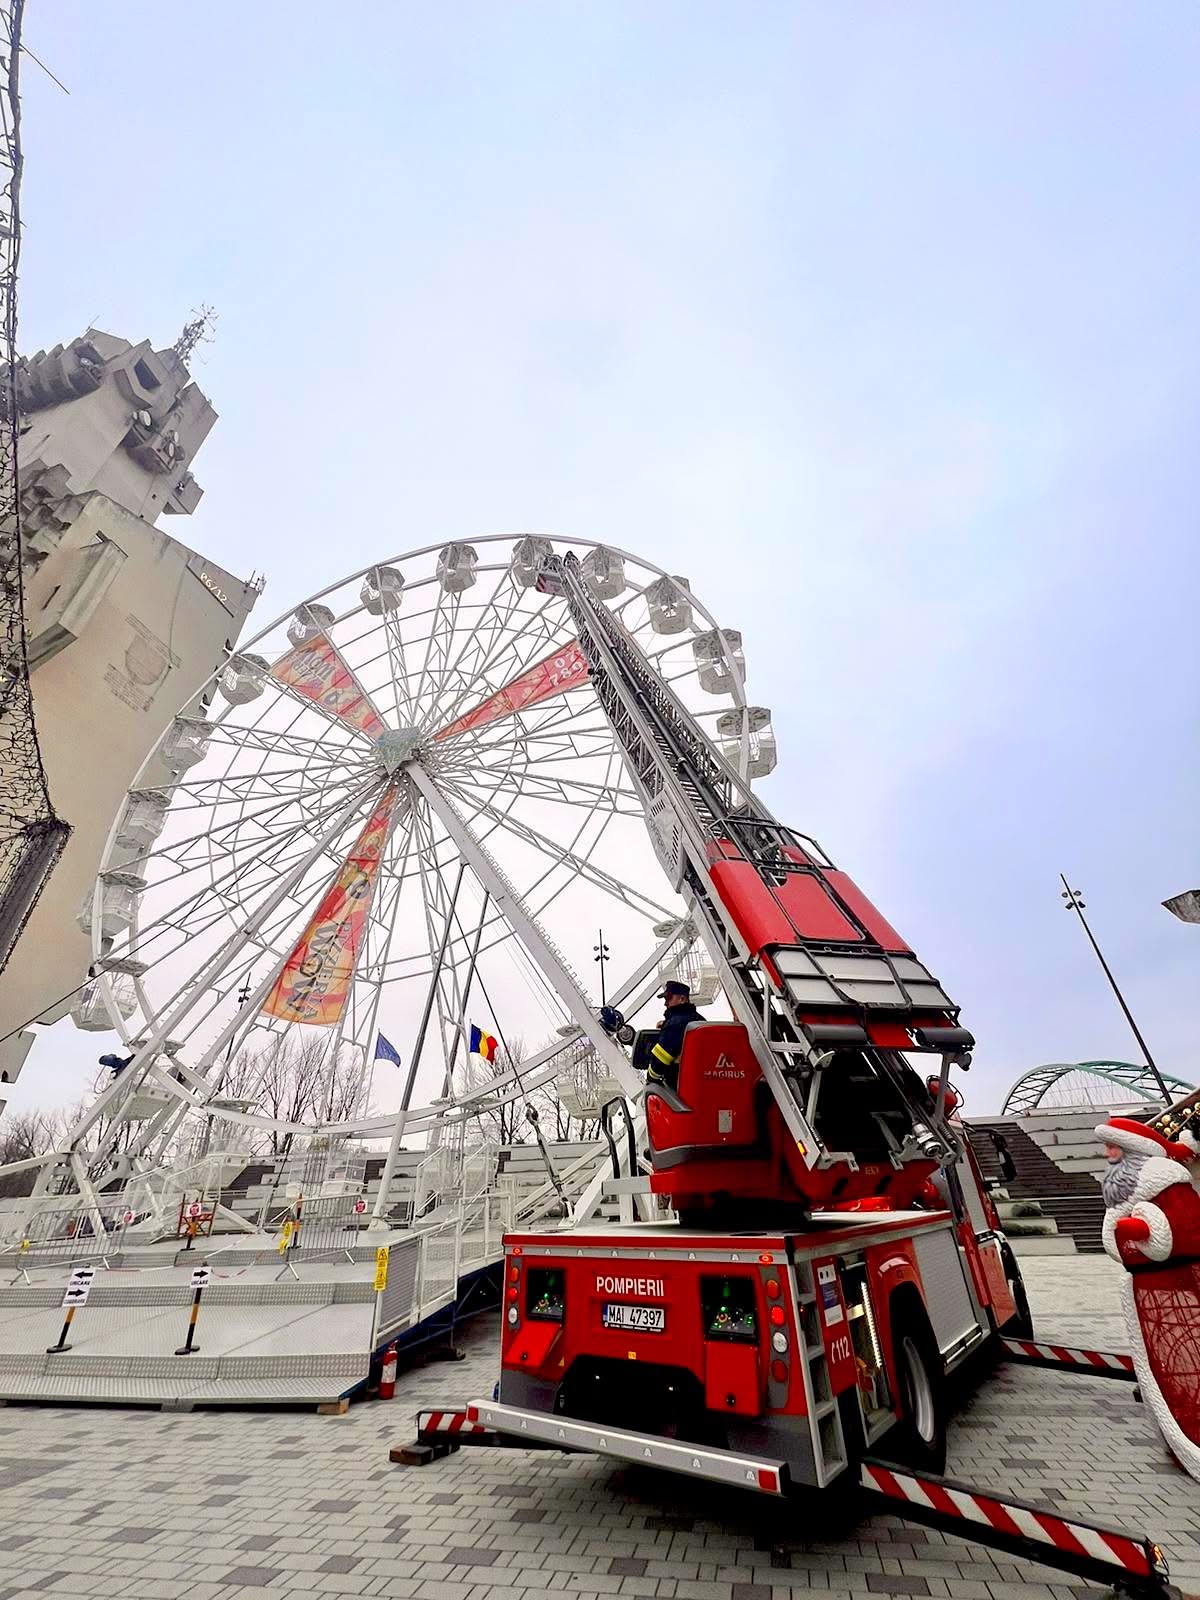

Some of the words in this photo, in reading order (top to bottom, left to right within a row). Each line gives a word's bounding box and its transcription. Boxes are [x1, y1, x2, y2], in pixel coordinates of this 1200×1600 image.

[200, 572, 227, 604] 06/12
[596, 1276, 664, 1297] POMPIERII
[608, 1306, 625, 1323] MAI
[630, 1308, 662, 1327] 47397
